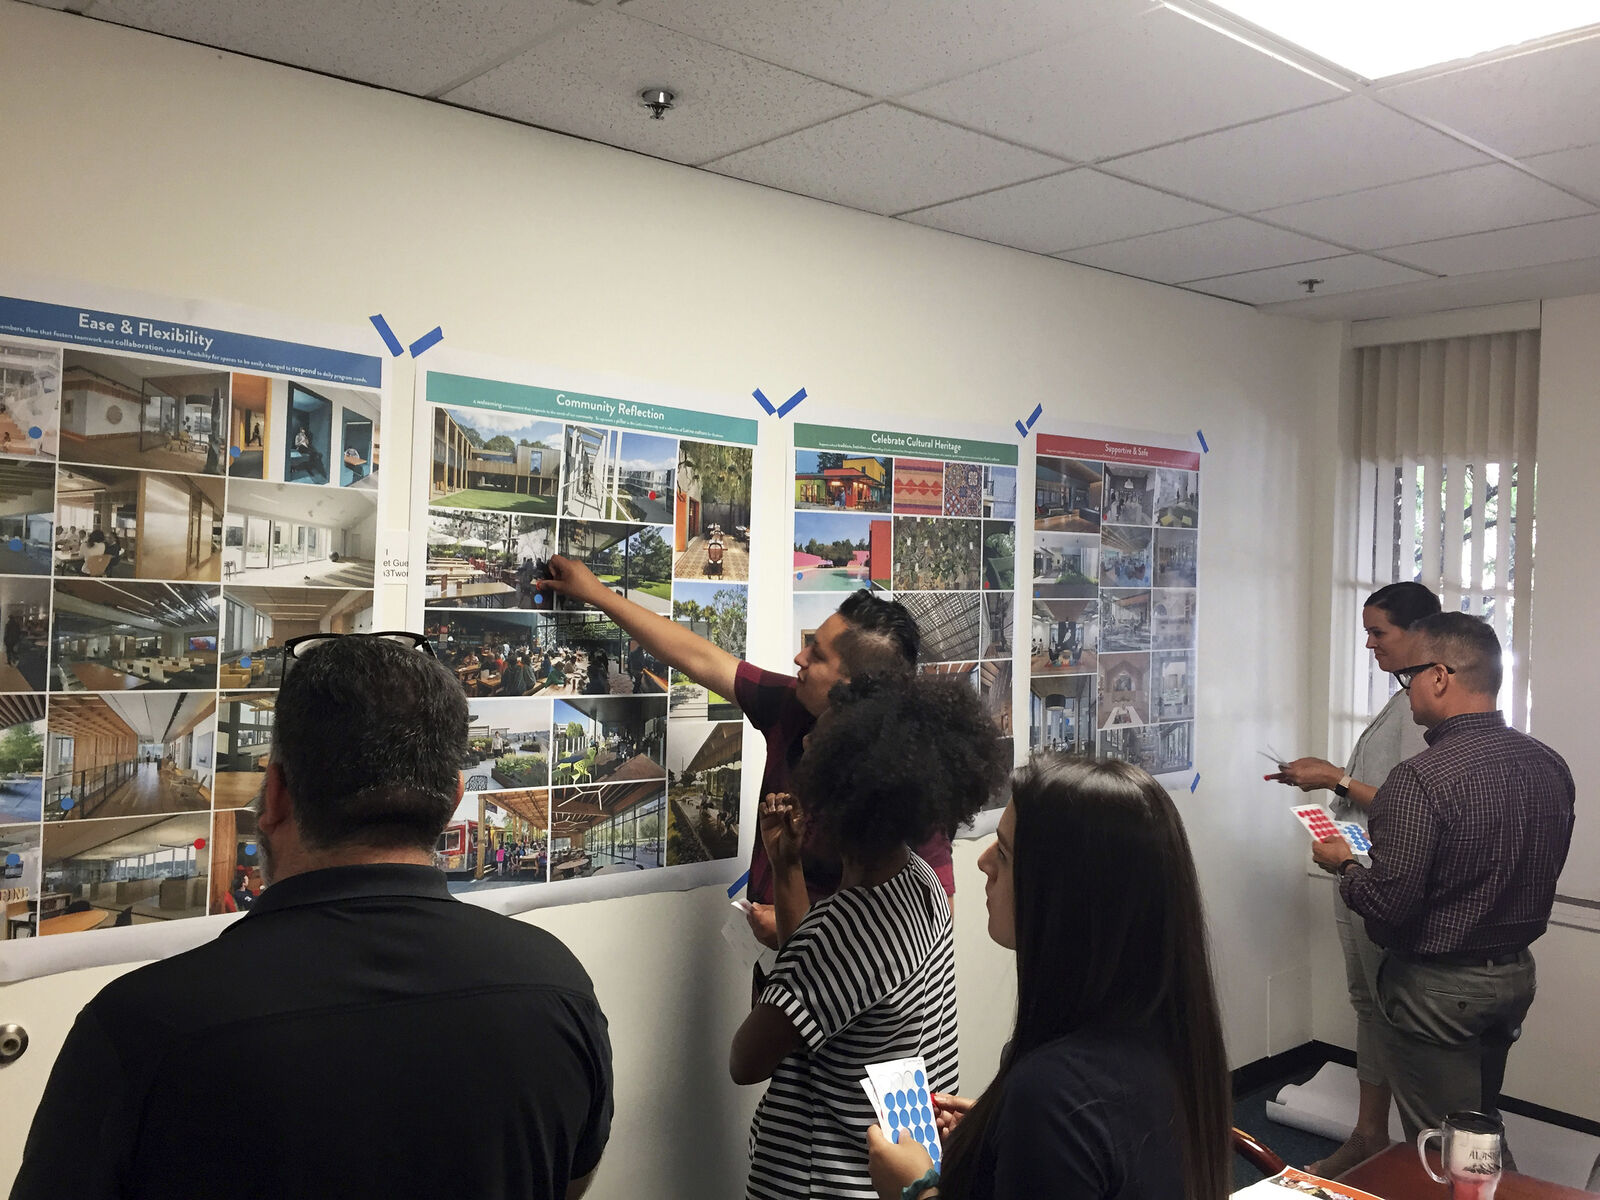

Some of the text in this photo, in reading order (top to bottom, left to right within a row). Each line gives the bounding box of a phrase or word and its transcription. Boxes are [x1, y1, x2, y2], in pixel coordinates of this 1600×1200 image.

[78, 312, 214, 351] Ease & Flexibility
[53, 330, 73, 338] fosters
[74, 334, 102, 342] teamwork
[115, 339, 165, 352] collaboration,
[187, 350, 211, 360] flexibility
[251, 360, 264, 368] easily
[265, 362, 285, 371] changed
[292, 366, 317, 375] respond
[323, 370, 333, 379] daily
[556, 394, 665, 421] Community Reflection
[871, 433, 905, 447] Celebrate
[906, 436, 934, 448] Cultural
[934, 439, 962, 453] Heritage
[1104, 443, 1149, 457] Supportive & Safe
